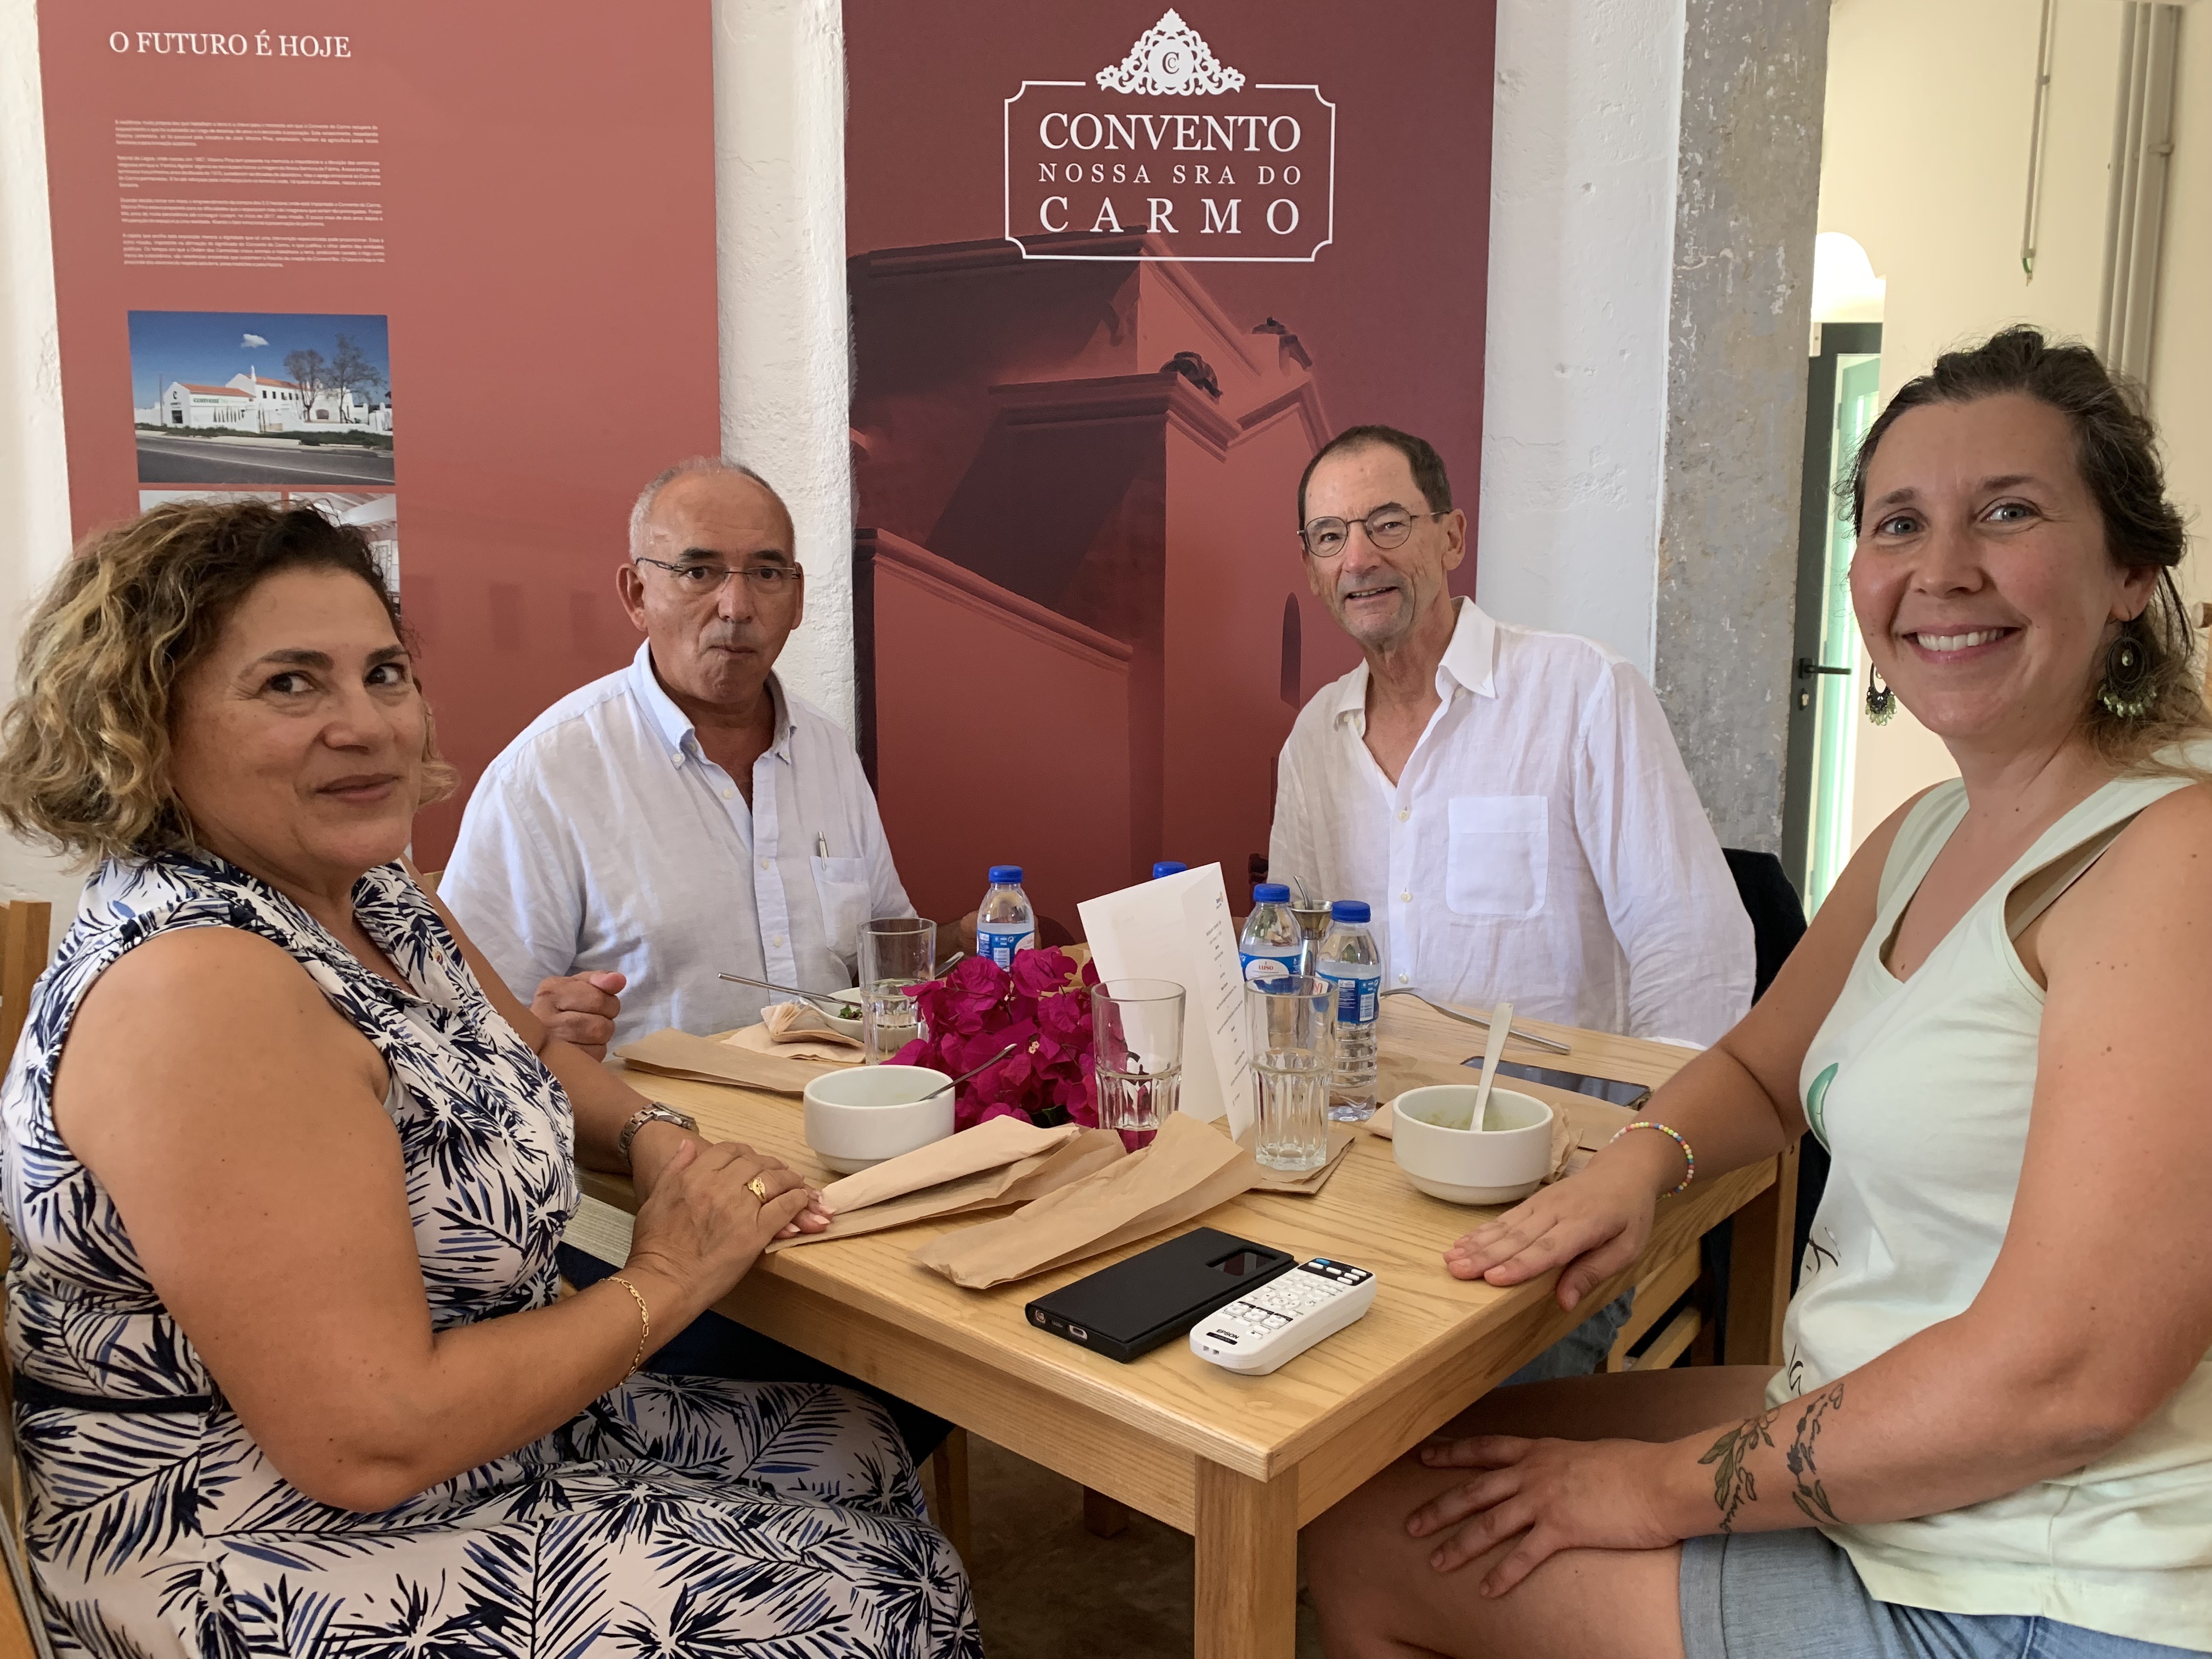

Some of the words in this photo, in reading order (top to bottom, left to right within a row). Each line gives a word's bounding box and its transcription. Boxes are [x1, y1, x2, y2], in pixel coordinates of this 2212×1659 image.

[109, 31, 129, 53] O
[136, 32, 247, 55] FUTURO
[254, 29, 272, 56] É
[278, 35, 351, 58] HOJE
[1040, 112, 1301, 152] CONVENTO
[1039, 163, 1151, 183] NOSSA
[1173, 165, 1235, 184] SRA
[1258, 166, 1301, 185] DO
[1040, 196, 1299, 235] CARMO
[1216, 1329, 1239, 1339] EPSON
